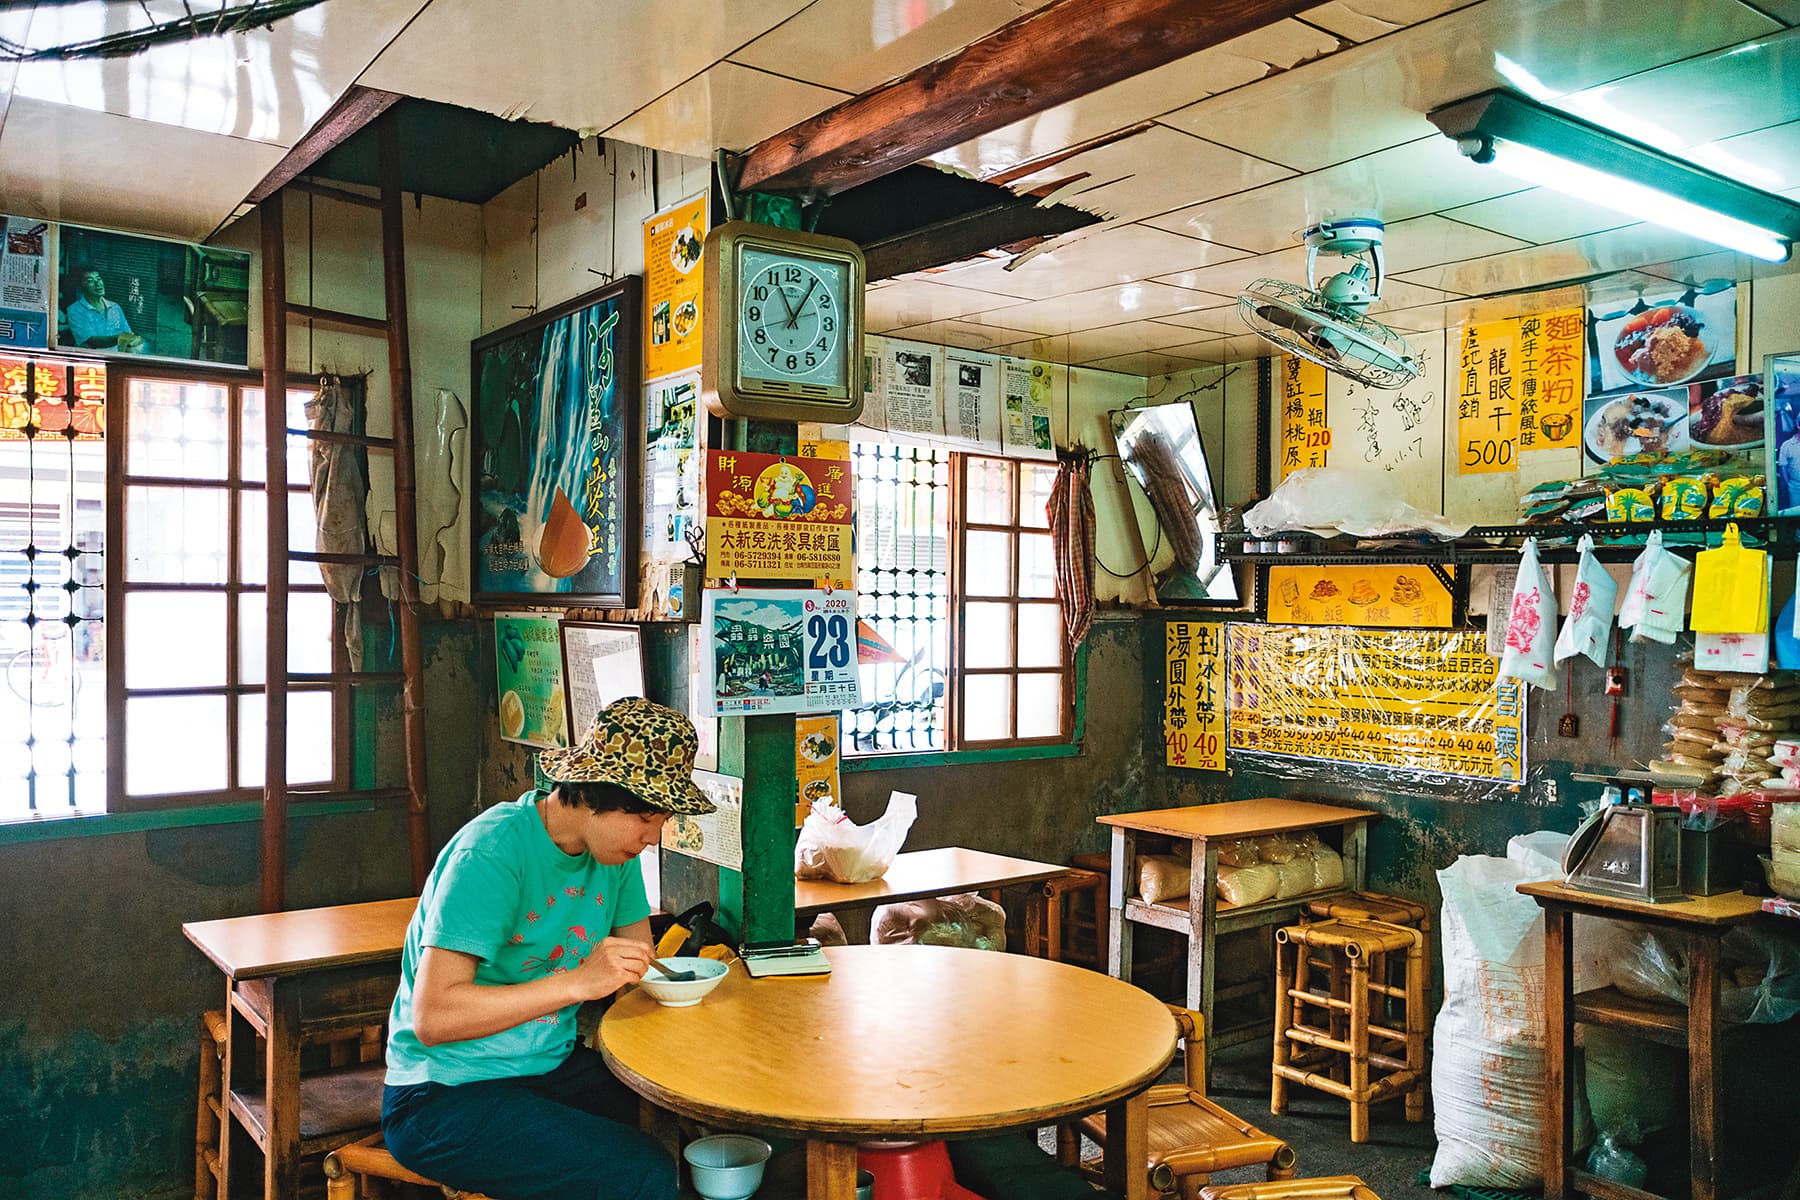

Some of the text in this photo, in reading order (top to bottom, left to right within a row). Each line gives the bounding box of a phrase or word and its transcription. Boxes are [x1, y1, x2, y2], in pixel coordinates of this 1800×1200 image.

[767, 270, 780, 287] 11
[785, 267, 801, 284] 12
[753, 286, 768, 302] 10
[819, 294, 831, 309] 2
[749, 307, 760, 322] 9
[823, 316, 834, 332] 3
[754, 328, 767, 345] 8
[816, 337, 828, 351] 4
[767, 347, 779, 363] 7
[786, 355, 798, 370] 6
[805, 352, 816, 367] 5
[1540, 313, 1581, 405] 麵茶粉
[1459, 327, 1483, 420] 產地直銷
[1488, 348, 1515, 432] 龍眼干
[1284, 356, 1306, 476] 甕缸楊桃原
[1309, 393, 1324, 428] 一瓶
[1307, 430, 1331, 448] 120
[718, 456, 752, 493] 財源
[816, 465, 845, 500] 廣進
[720, 530, 841, 553] 大新免洗餐具總匯
[734, 551, 782, 561] 06-5729394
[796, 552, 841, 562] 06-5816880
[734, 560, 782, 569] 06-5711321
[825, 599, 847, 608] 2020
[807, 614, 851, 669] 23
[811, 670, 849, 682] 星期一
[1168, 623, 1192, 731] 湯圓外帶
[811, 683, 857, 694] 二月三十日
[1324, 729, 1337, 742] 50
[1351, 730, 1365, 742] 40
[1367, 731, 1382, 742] 40
[1438, 738, 1454, 750] 40
[1458, 739, 1474, 751] 40
[1477, 741, 1492, 753] 40
